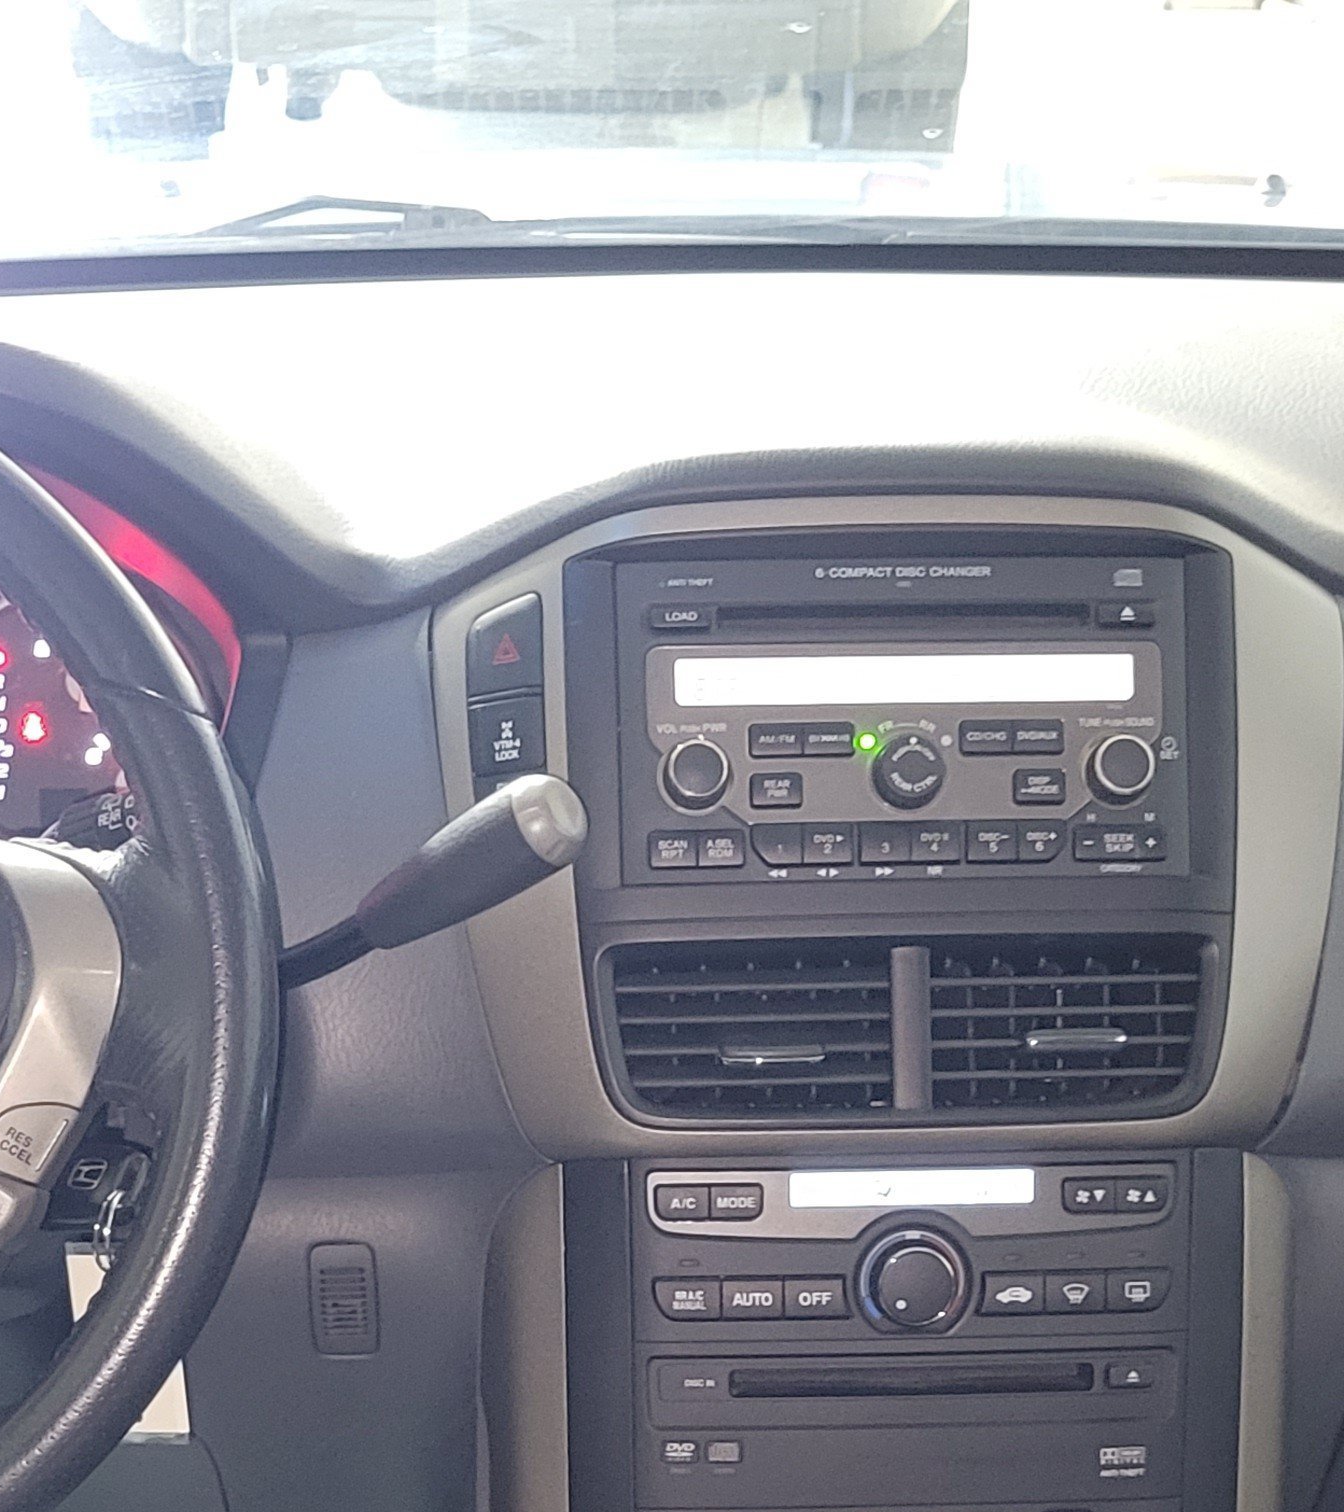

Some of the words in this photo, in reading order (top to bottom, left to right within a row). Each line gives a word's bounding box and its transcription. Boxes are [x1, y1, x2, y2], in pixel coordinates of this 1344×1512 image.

[814, 568, 825, 579] 6
[828, 567, 893, 578] COMPACT
[895, 567, 925, 577] DISC
[929, 566, 992, 577] CHANGER
[665, 611, 698, 622] LOAD
[878, 720, 893, 734] FR
[1078, 717, 1102, 728] TUNE
[656, 724, 677, 734] VOL
[702, 723, 727, 733] PWR
[758, 734, 796, 744] AM/FM
[495, 749, 520, 762] LOCK
[1159, 750, 1179, 760] SET
[763, 779, 792, 790] REAR
[890, 771, 913, 792] REAR
[913, 775, 938, 793] CTRL
[97, 808, 121, 827] REAR
[813, 833, 835, 844] DVD
[1104, 833, 1135, 843] SEEK
[658, 839, 688, 850] SCAN
[824, 843, 833, 854] 2
[880, 842, 891, 854] 3
[930, 842, 940, 853] 4
[989, 841, 999, 853] 5
[1034, 841, 1045, 852] 6
[1105, 843, 1134, 853] SKIP
[661, 848, 684, 859] RPT
[707, 848, 733, 859] RDM
[6, 1126, 33, 1148] RES
[670, 1197, 698, 1210] A/C
[716, 1196, 757, 1209] MODE
[732, 1292, 773, 1307] AUTO
[798, 1291, 833, 1307] OFF
[684, 1378, 705, 1388] DISC
[665, 1442, 696, 1452] DVD
